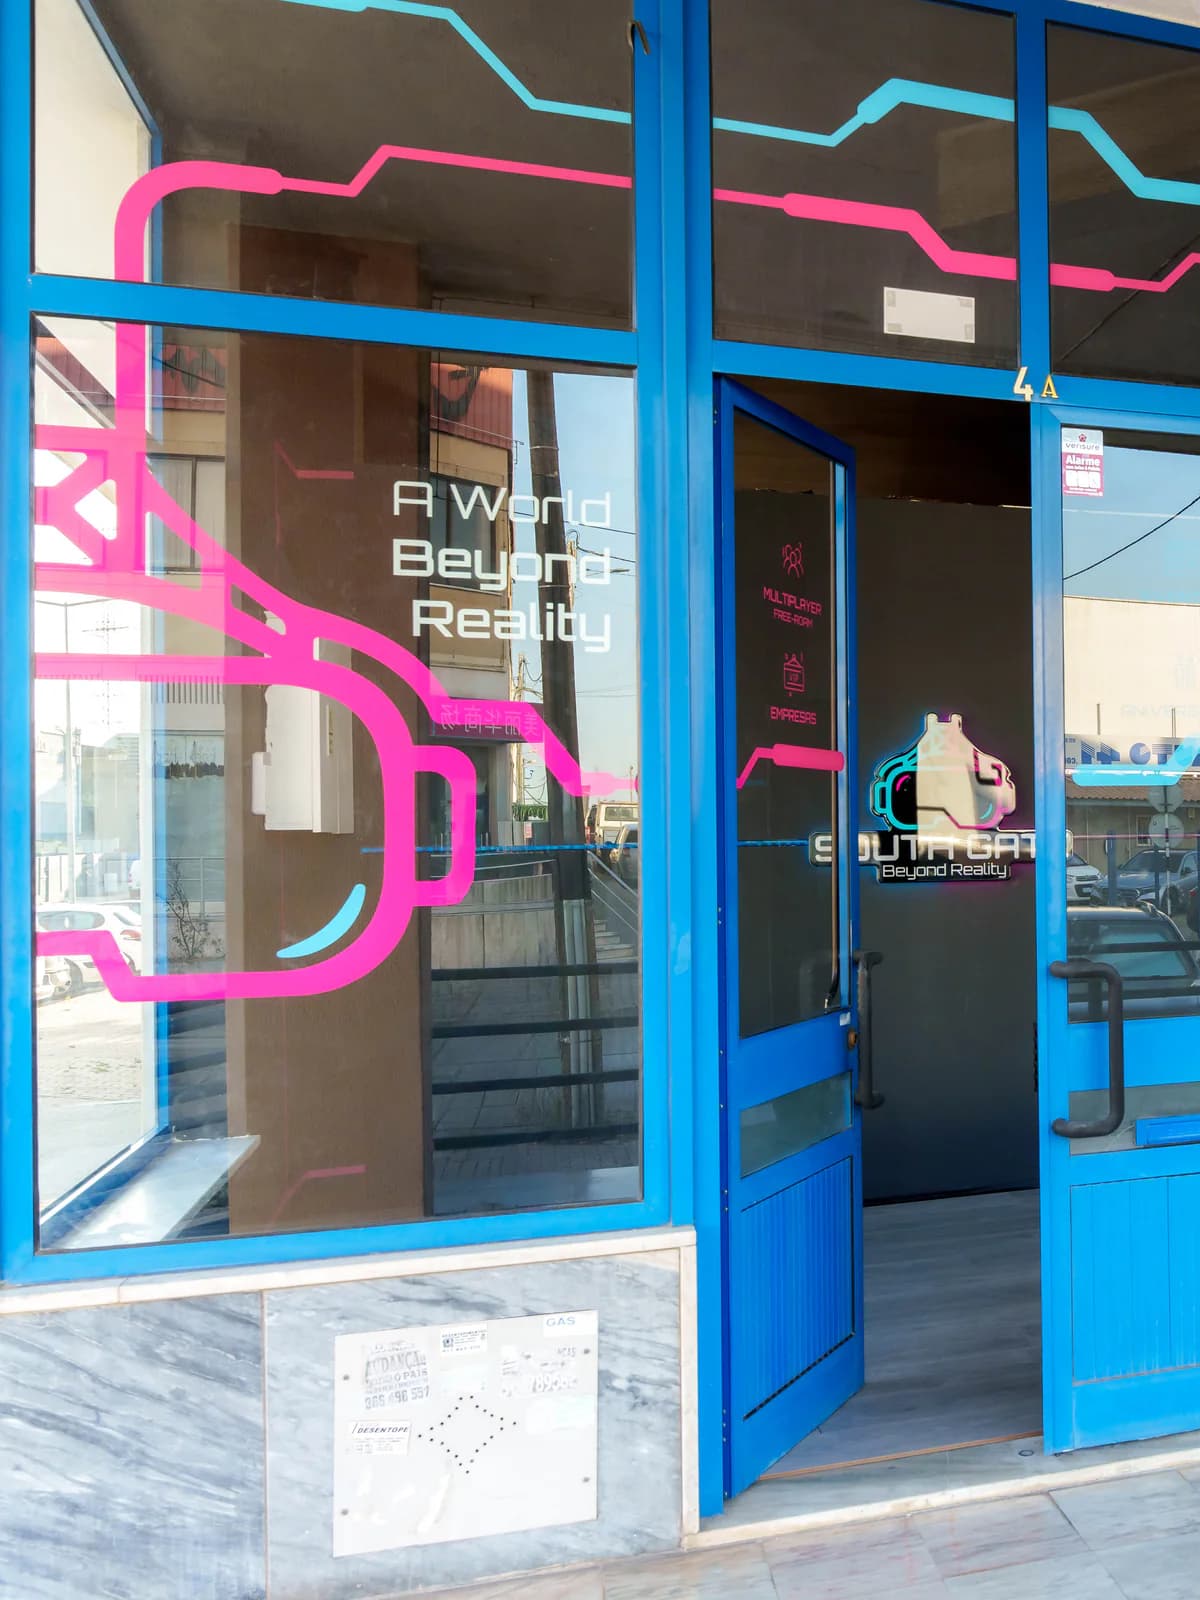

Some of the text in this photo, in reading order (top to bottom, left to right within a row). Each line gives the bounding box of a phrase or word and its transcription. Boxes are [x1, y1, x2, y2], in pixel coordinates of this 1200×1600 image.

[1013, 366, 1059, 402] 4 A
[1066, 454, 1100, 467] Alarme
[393, 480, 611, 528] A World
[392, 538, 611, 592] Beyond
[763, 586, 823, 616] MULTIPLAYER
[412, 599, 611, 653] Reality
[769, 706, 817, 725] EMPRESAS
[966, 833, 1037, 860] GAT
[882, 862, 1008, 880] Beyond Reality
